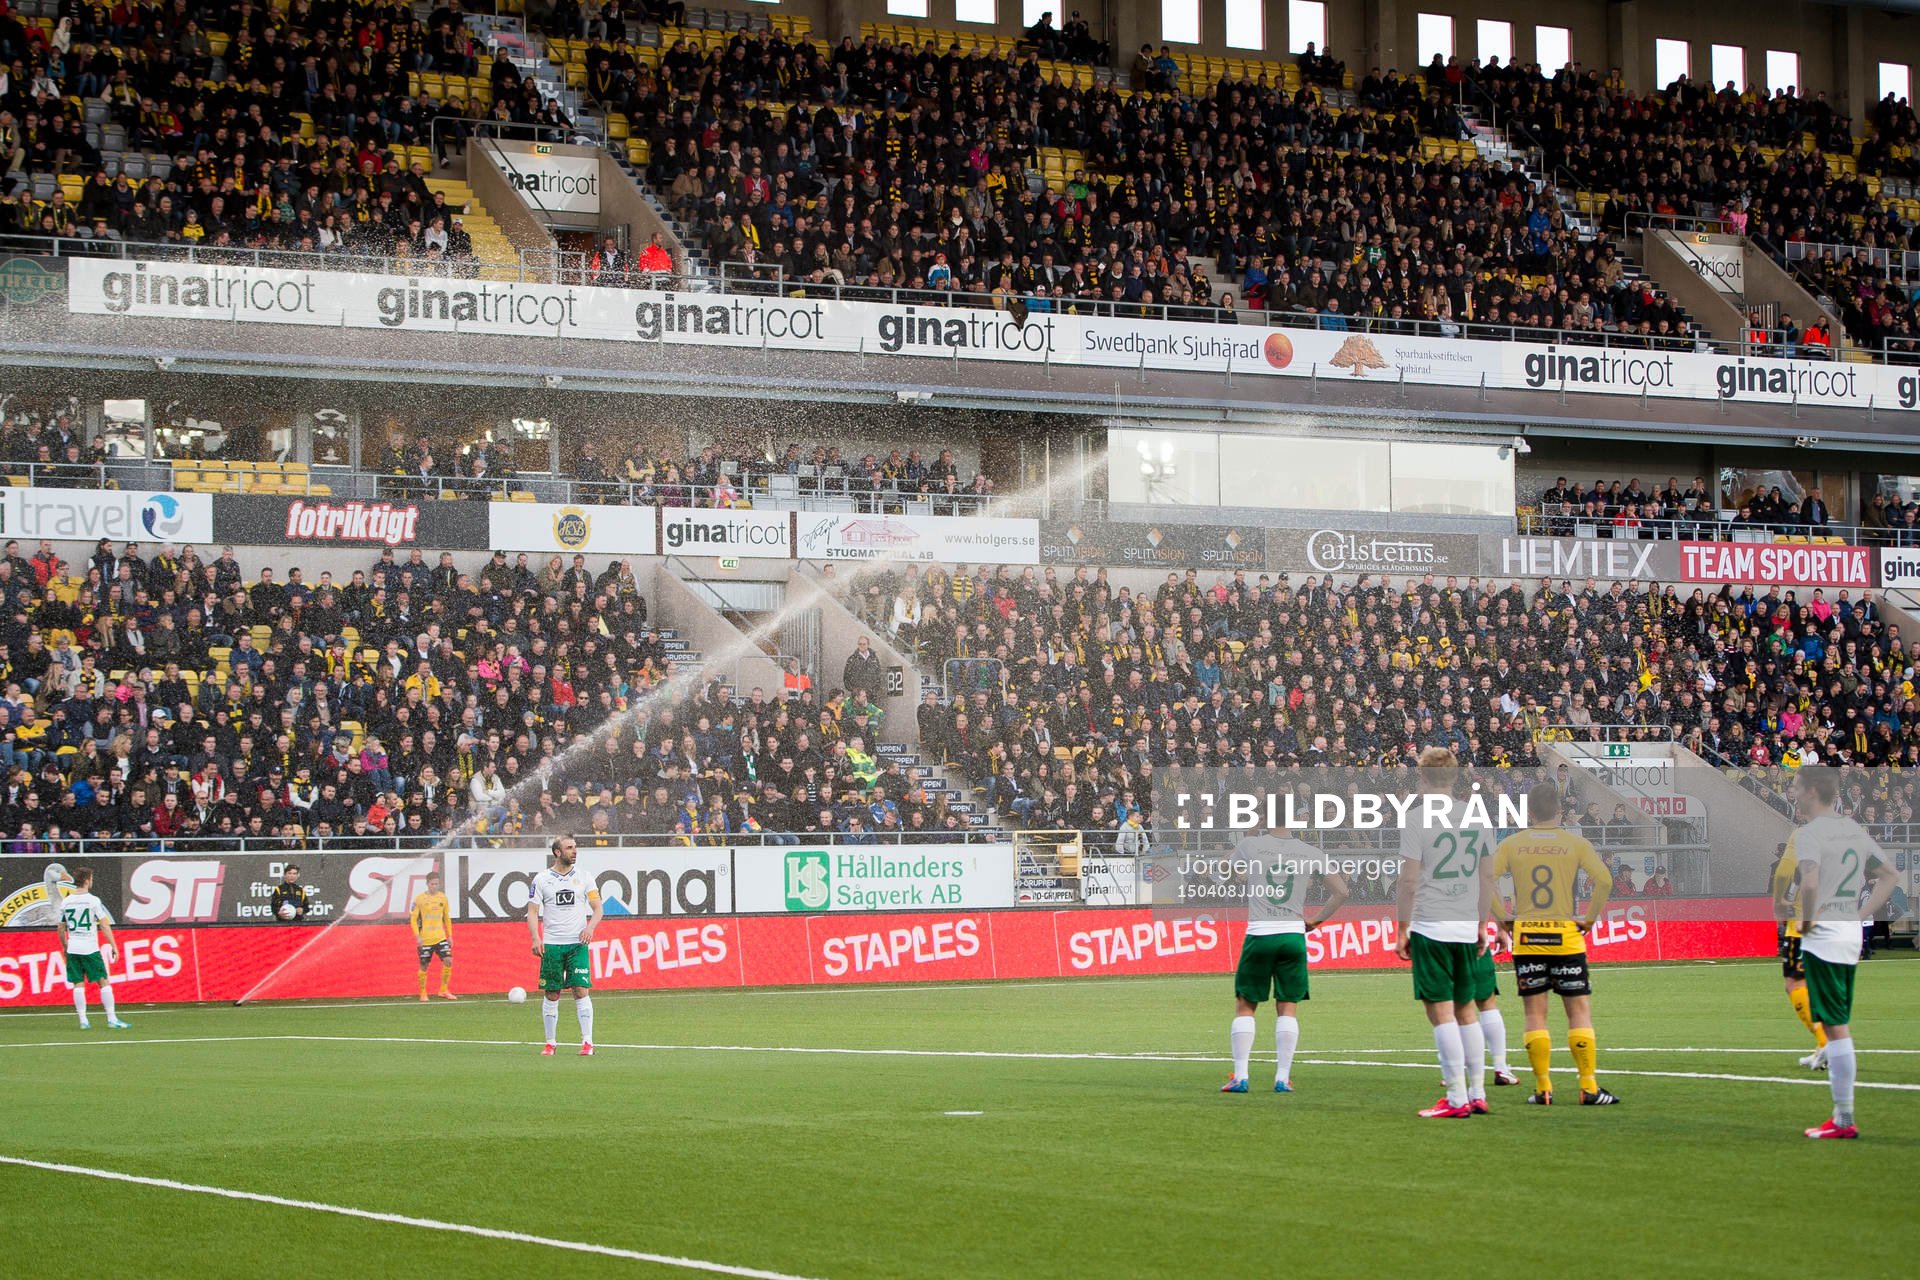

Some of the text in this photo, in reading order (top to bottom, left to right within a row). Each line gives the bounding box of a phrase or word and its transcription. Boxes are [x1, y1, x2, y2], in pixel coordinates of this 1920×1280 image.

[102, 262, 315, 313] ginatricot
[376, 278, 578, 327] ginatricot
[636, 293, 825, 340] ginatricot
[878, 306, 1056, 353] ginatricot
[1085, 330, 1178, 354] Swedbank
[1183, 335, 1260, 362] Sjuhärad
[1525, 345, 1673, 388] ginatricot
[1395, 362, 1431, 375] Suhärad
[1716, 357, 1857, 399] ginatricot
[20, 493, 131, 539] travel
[287, 501, 418, 545] fotriktigt
[666, 517, 787, 548] ginatricot
[826, 548, 915, 560] STUGMATRIAL
[944, 533, 1035, 552] www.holgers.se
[1306, 529, 1449, 571] Carlsteins.se
[1502, 538, 1656, 578] HEMTEX
[1683, 545, 1866, 584] TEAM SPORTIA
[837, 853, 963, 879] Hållanders
[1082, 862, 1136, 877] ginatricot
[1432, 830, 1479, 880] 23
[1834, 847, 1860, 898] 2
[837, 884, 963, 910] Sågverk AB
[1085, 884, 1133, 896] ginatricot
[1265, 863, 1294, 906] 9
[1531, 864, 1554, 910] 8
[64, 908, 92, 932] 34
[1069, 913, 1219, 970] STAPLES
[1305, 916, 1398, 964] STAPL
[0, 934, 183, 1000] STALES
[590, 923, 728, 980] TAPLES
[822, 917, 980, 977] STAPLES
